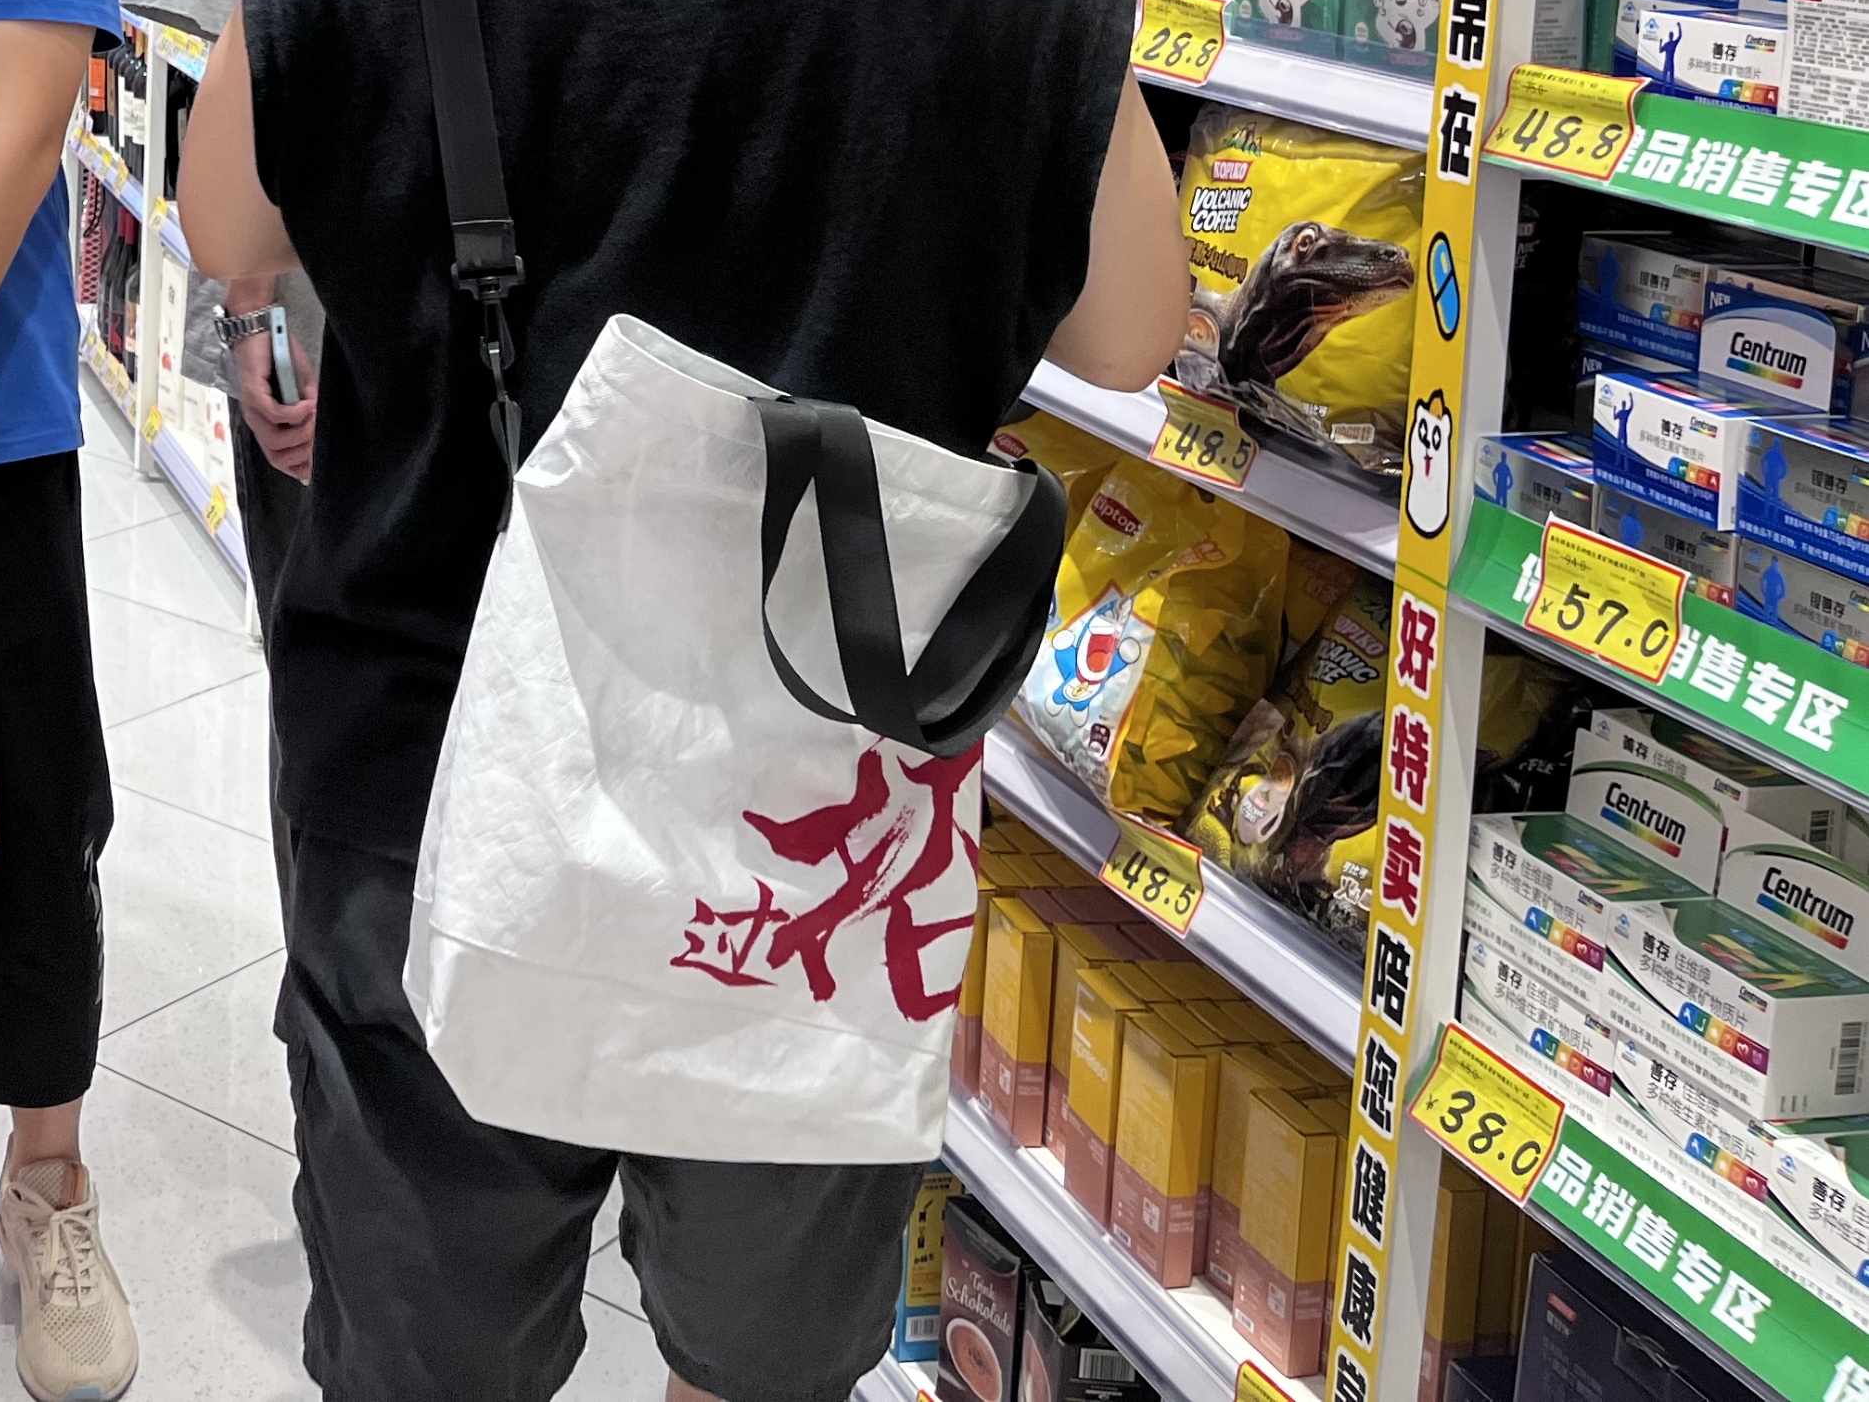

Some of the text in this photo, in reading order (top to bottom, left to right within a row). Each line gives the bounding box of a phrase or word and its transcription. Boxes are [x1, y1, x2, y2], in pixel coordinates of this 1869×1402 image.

[1142, 27, 1219, 67] 28.8
[1712, 34, 1776, 62] 善存 Centrum
[1512, 107, 1624, 161] 48.8
[1214, 162, 1248, 180] KOPIKO
[1190, 186, 1252, 216] VOLCANIC
[1192, 210, 1241, 232] COFFEE
[1730, 332, 1807, 376] Centrum
[1174, 422, 1251, 470] 48.5
[1660, 418, 1684, 441] 善存
[1557, 583, 1670, 658] 57.0
[1604, 782, 1686, 846] Centrum
[1493, 841, 1518, 870] 善存
[1122, 851, 1196, 915] 48.5
[1763, 867, 1855, 936] Centrum
[1641, 931, 1670, 961] 善存
[1497, 960, 1523, 989] 善存
[1649, 1059, 1678, 1091] 善存
[1438, 1090, 1540, 1177] 38.0
[1541, 1143, 1772, 1344] 品销售专区
[945, 1277, 1012, 1336] Schokolade
